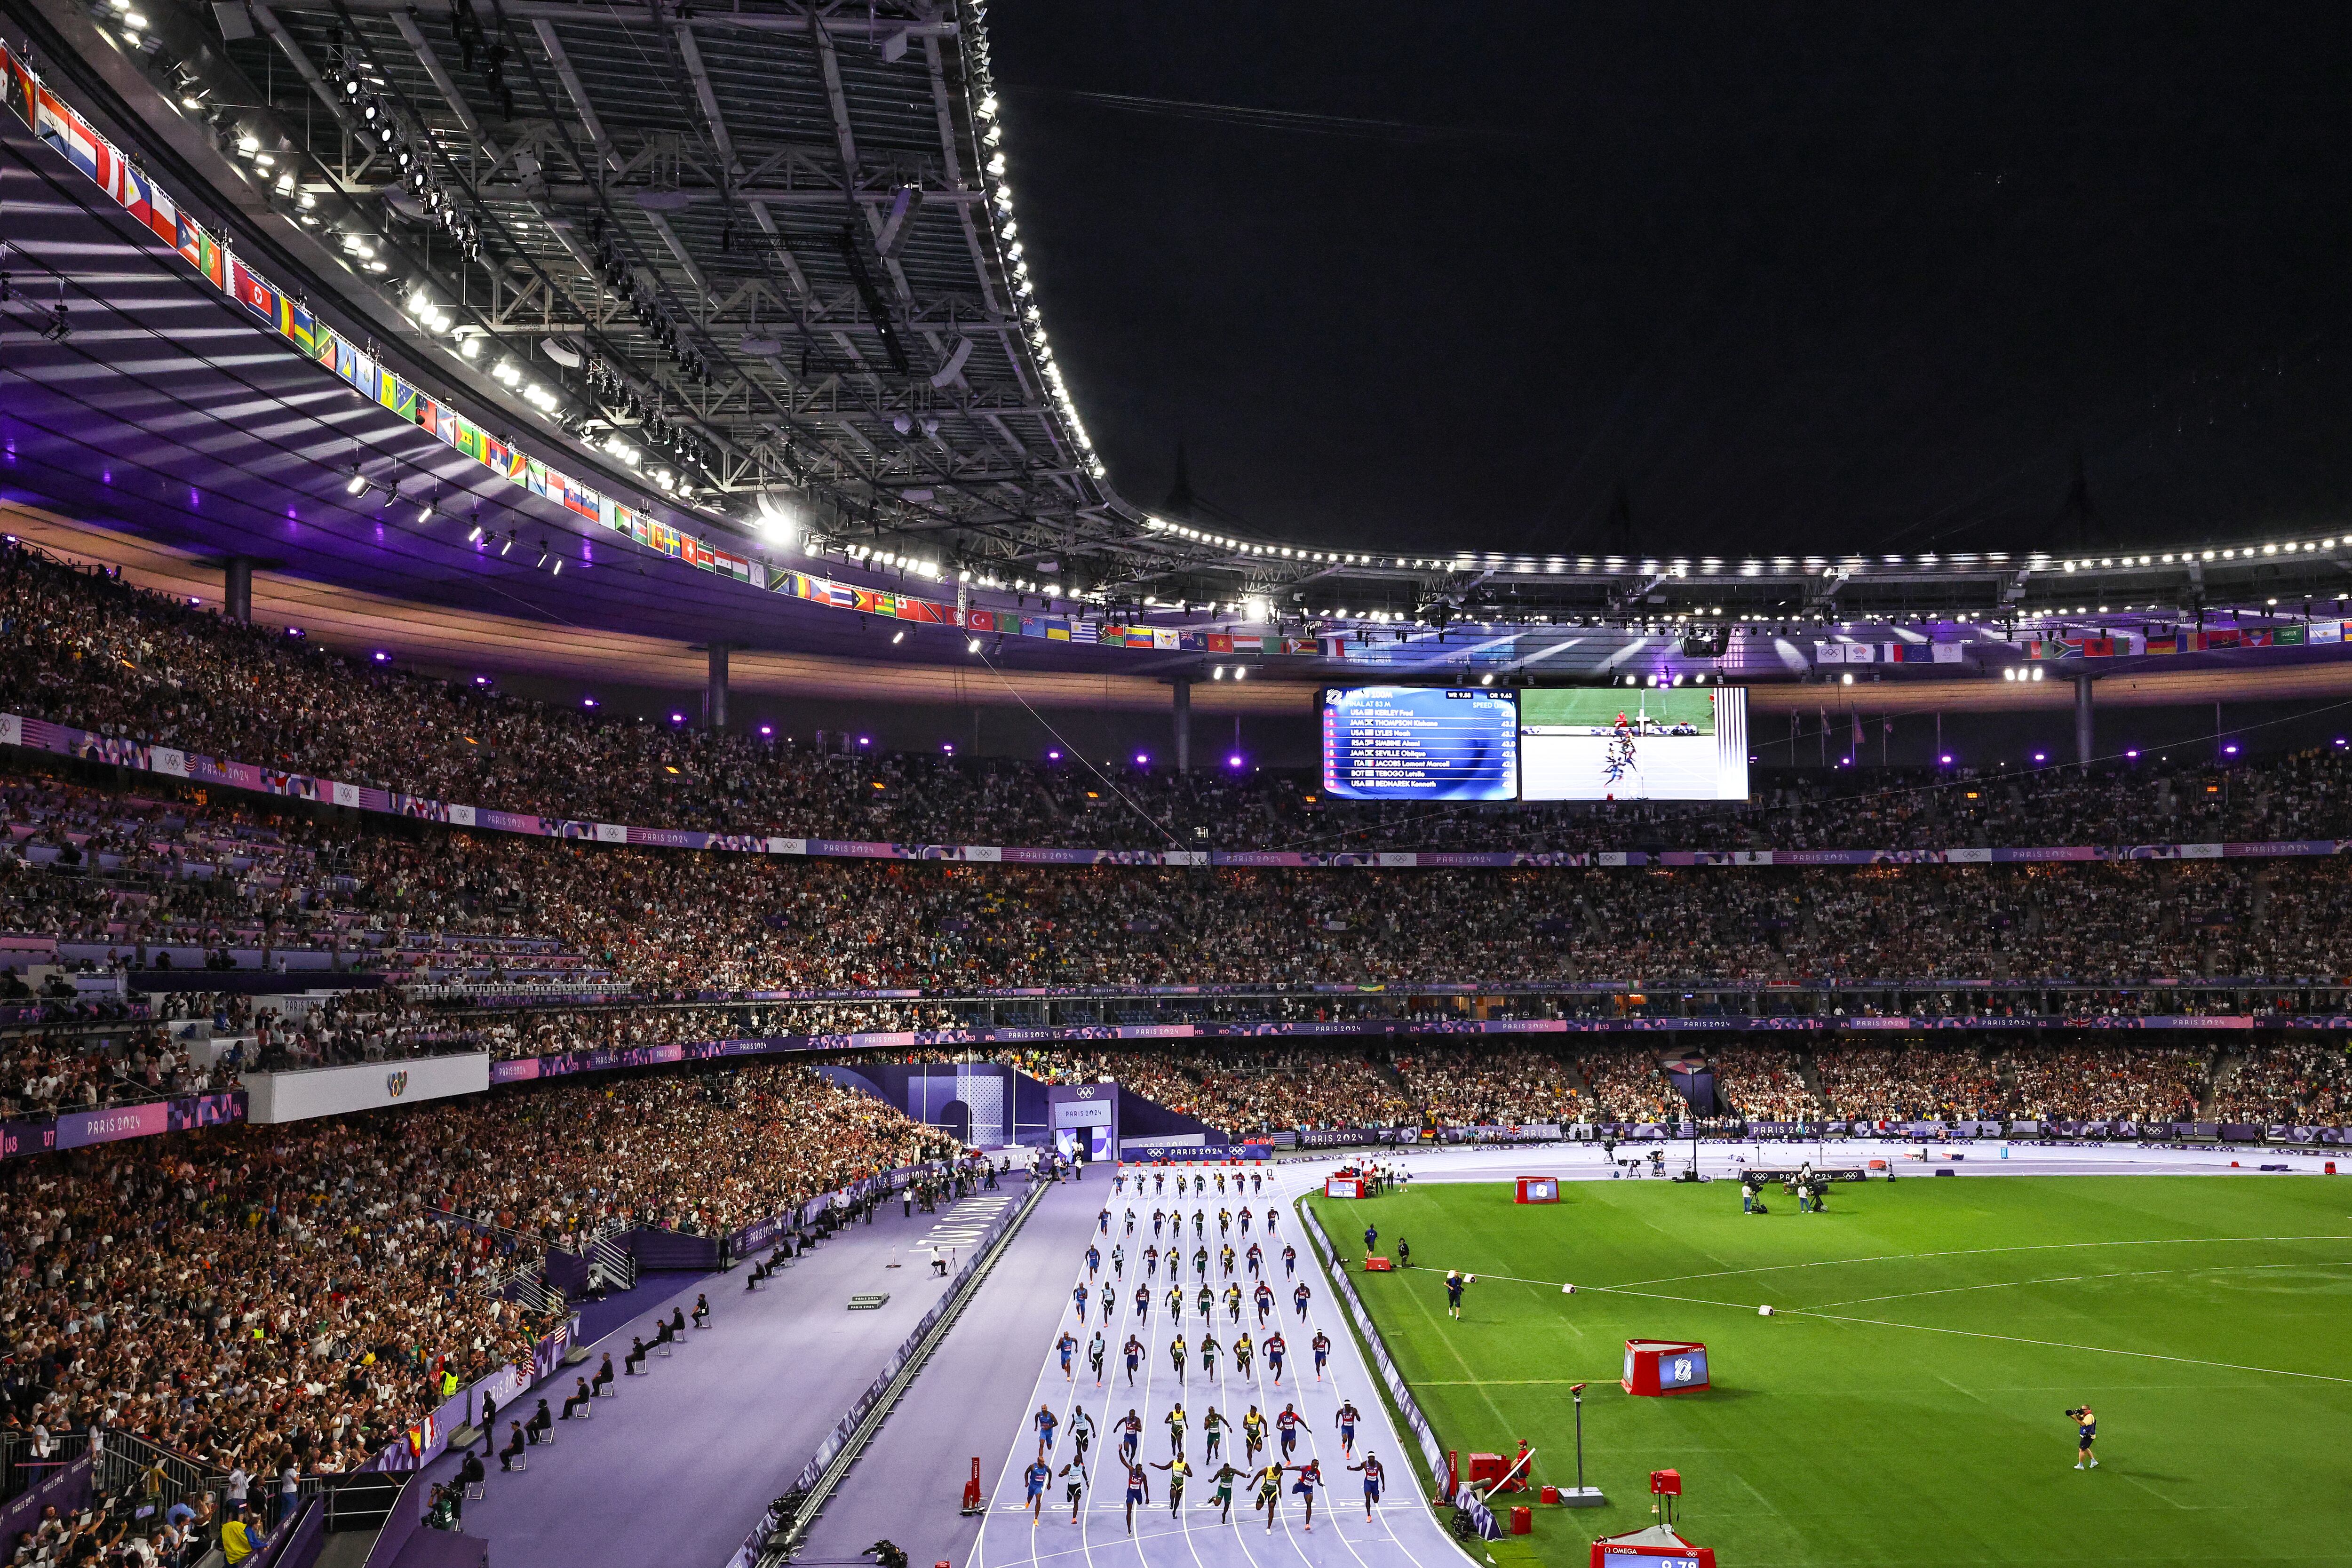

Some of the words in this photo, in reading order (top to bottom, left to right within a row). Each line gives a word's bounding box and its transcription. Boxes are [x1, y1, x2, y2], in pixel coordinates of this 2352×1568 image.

[229, 768, 248, 782] 2024
[508, 818, 525, 828] 2024
[667, 834, 688, 843] 2024
[514, 1066, 525, 1075] 2024
[233, 1103, 241, 1116] U6
[118, 1115, 140, 1131] 2024
[5, 1136, 18, 1153] U8
[44, 1130, 55, 1146] U7
[763, 1224, 774, 1238] 2024
[908, 1224, 990, 1252] 2024
